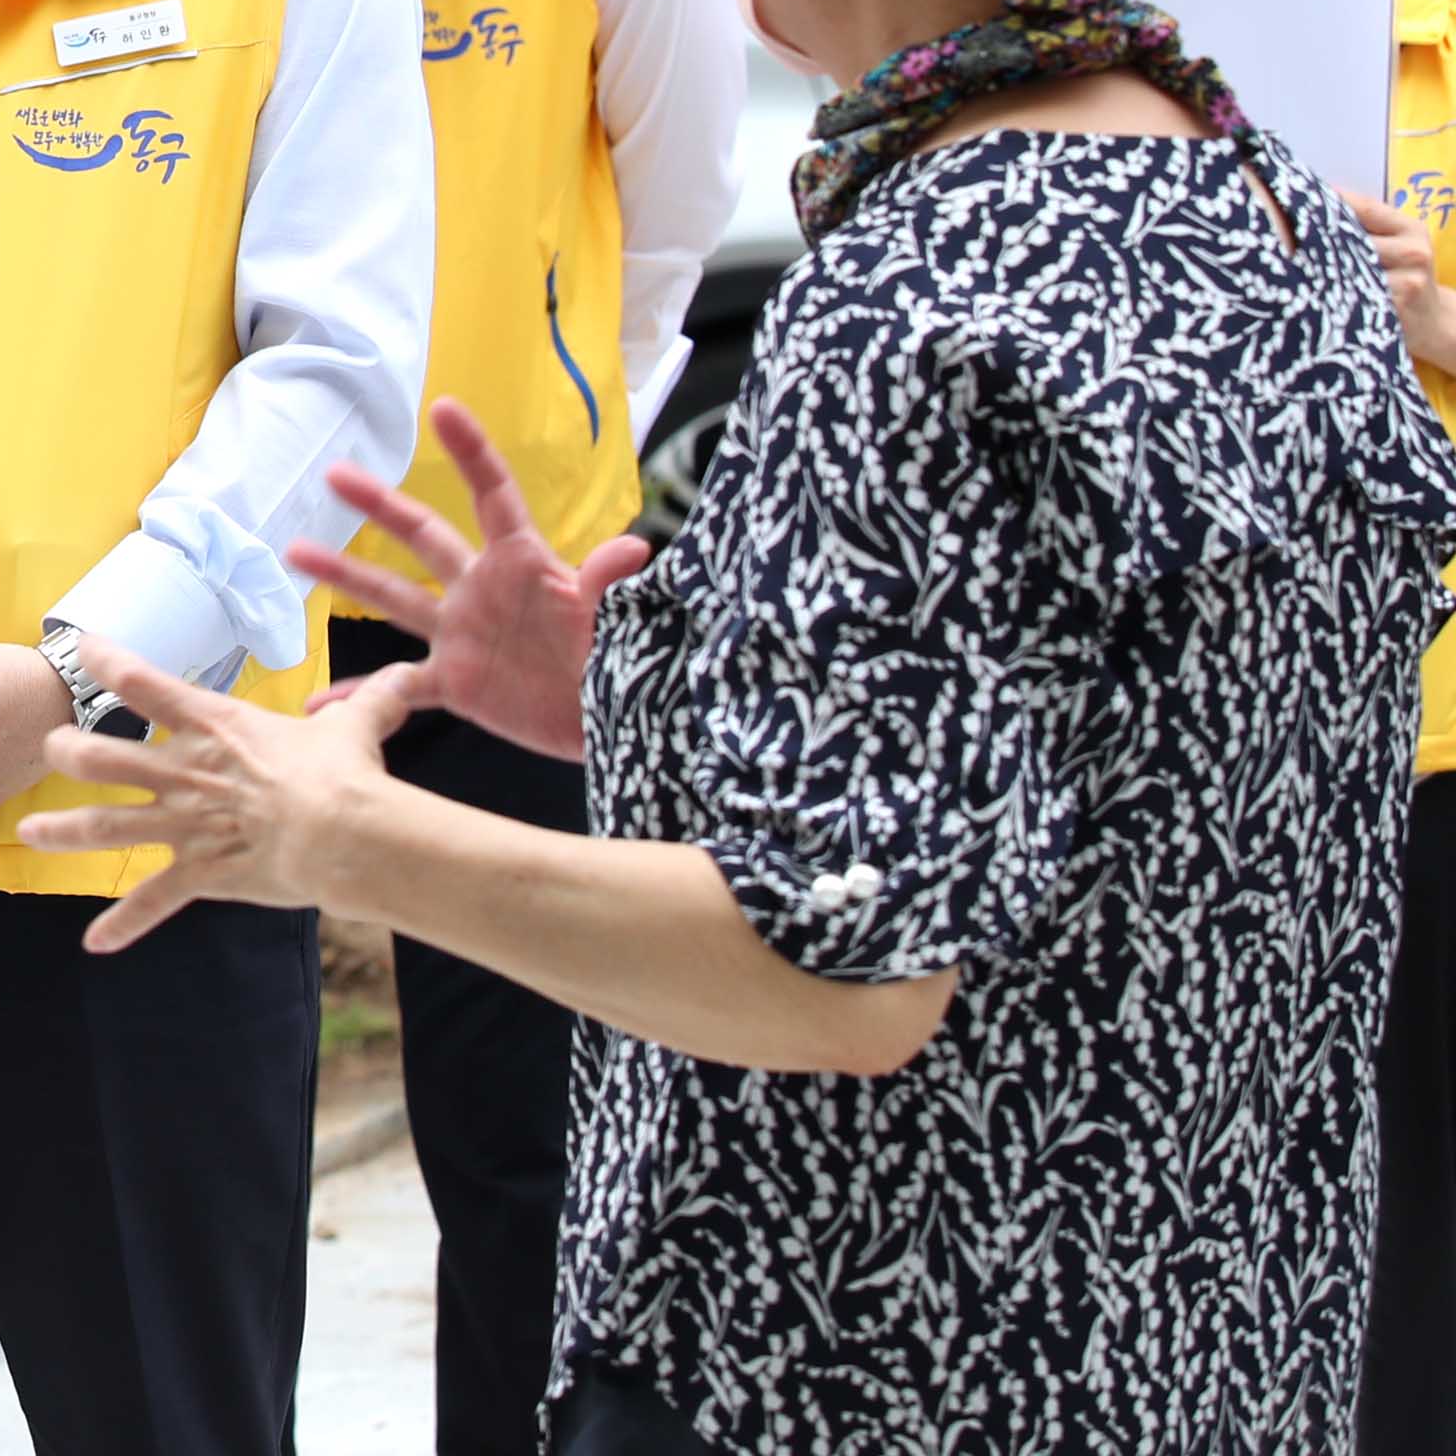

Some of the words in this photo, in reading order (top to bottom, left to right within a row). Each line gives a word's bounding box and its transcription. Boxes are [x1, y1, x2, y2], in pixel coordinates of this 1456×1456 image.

[471, 8, 524, 67] 동구
[15, 107, 49, 127] 새로운
[52, 109, 84, 128] 변화
[33, 131, 66, 151] 모두가
[69, 131, 103, 153] 행복한
[122, 110, 191, 185] 동구
[1408, 171, 1456, 230] 동구
